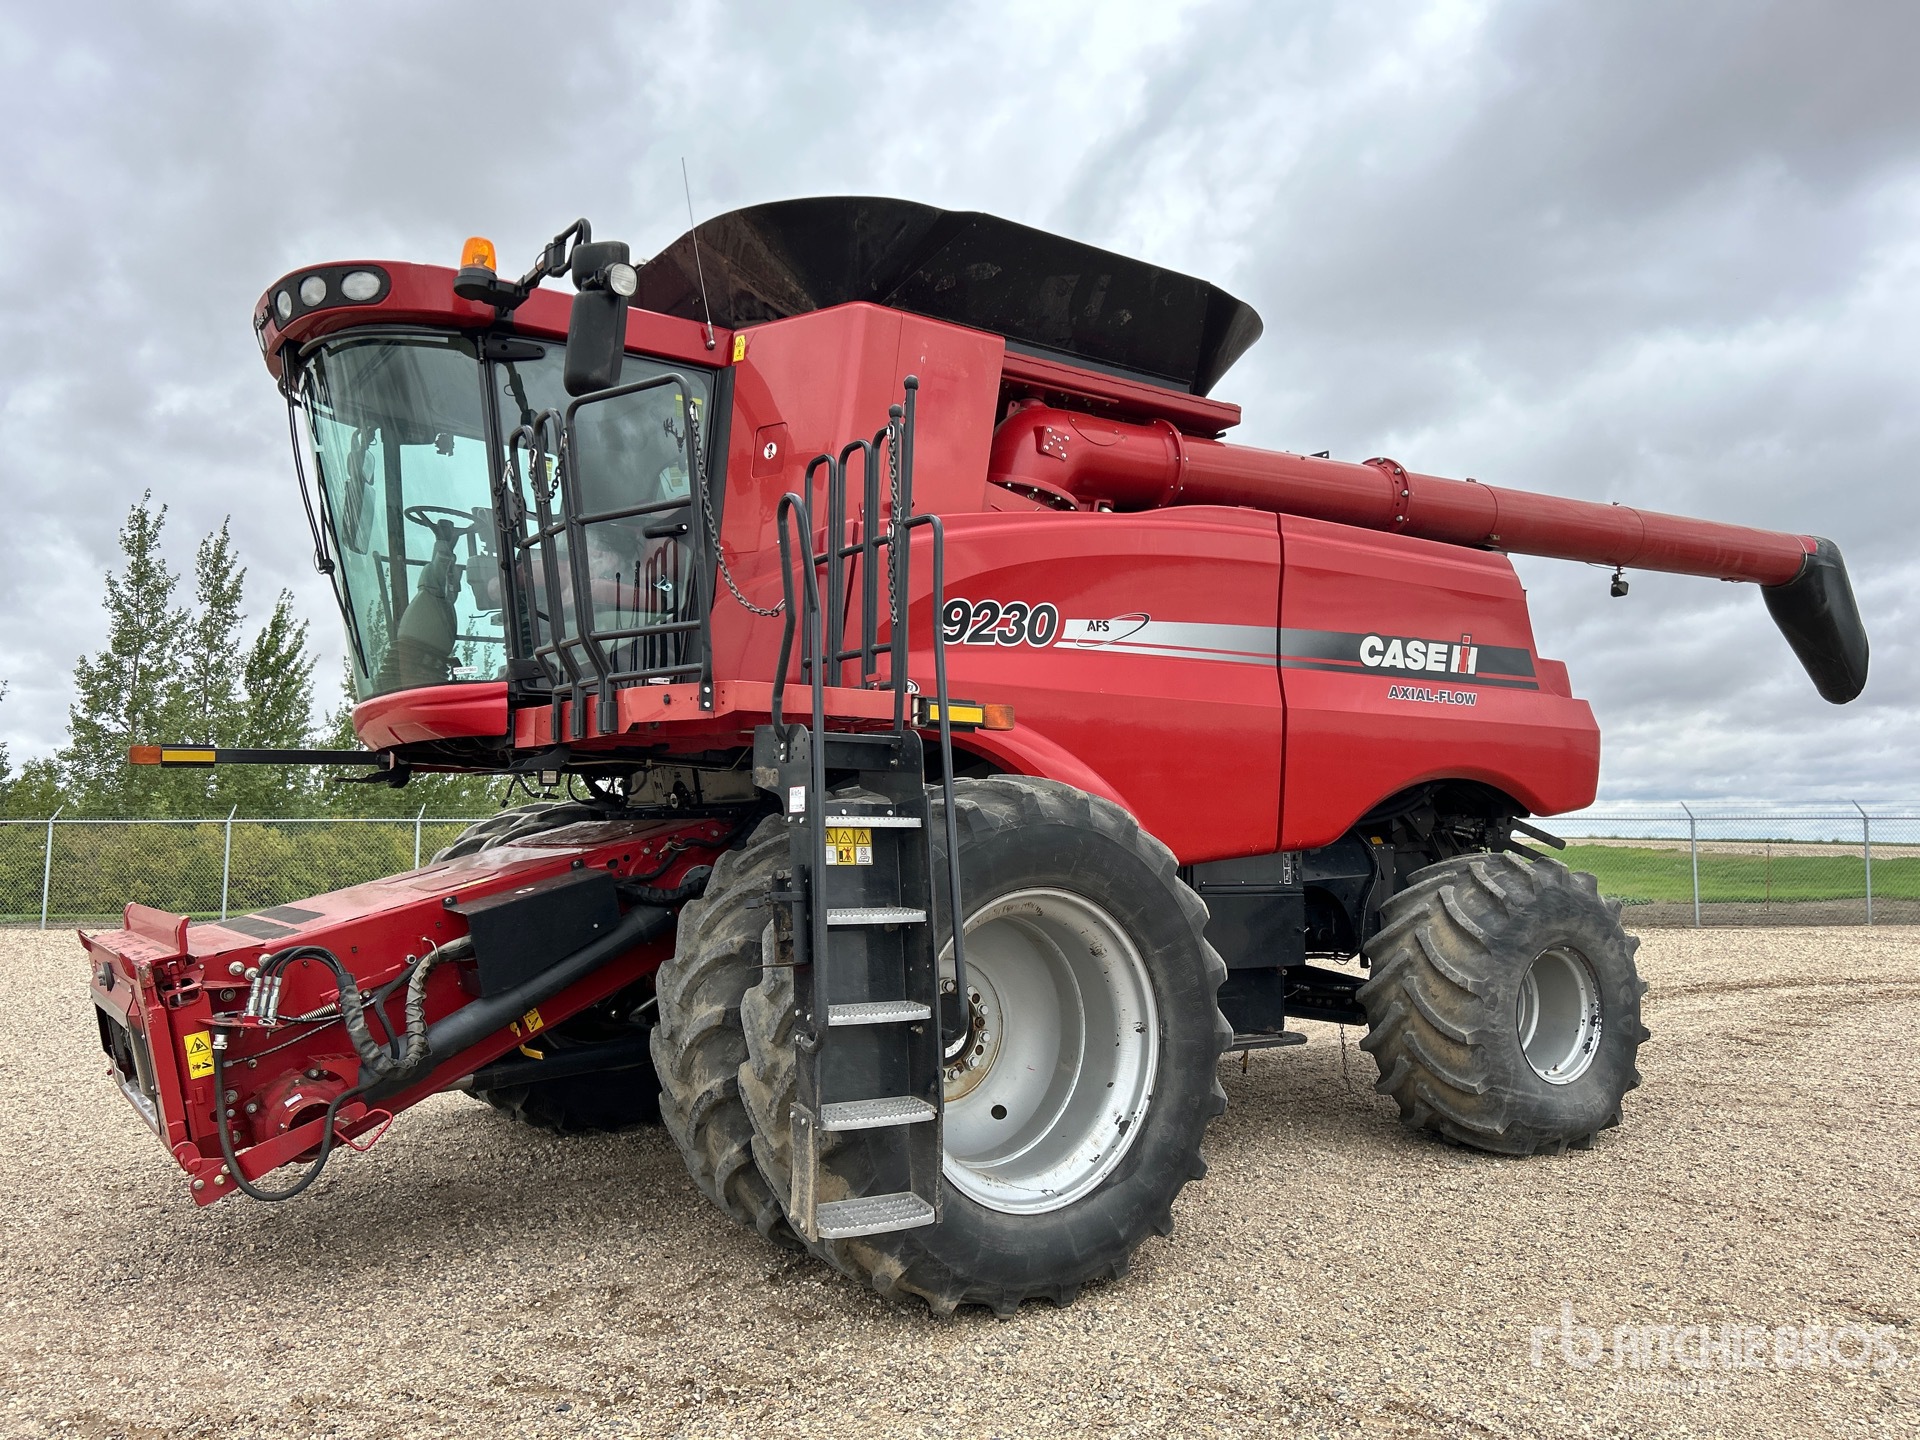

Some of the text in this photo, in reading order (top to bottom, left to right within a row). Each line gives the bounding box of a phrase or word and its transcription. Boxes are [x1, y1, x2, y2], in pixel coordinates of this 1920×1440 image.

[943, 598, 1059, 647] 9230
[1086, 619, 1110, 632] AFS
[1359, 635, 1448, 672] CASE
[1388, 685, 1478, 706] AXIAL-FLOW
